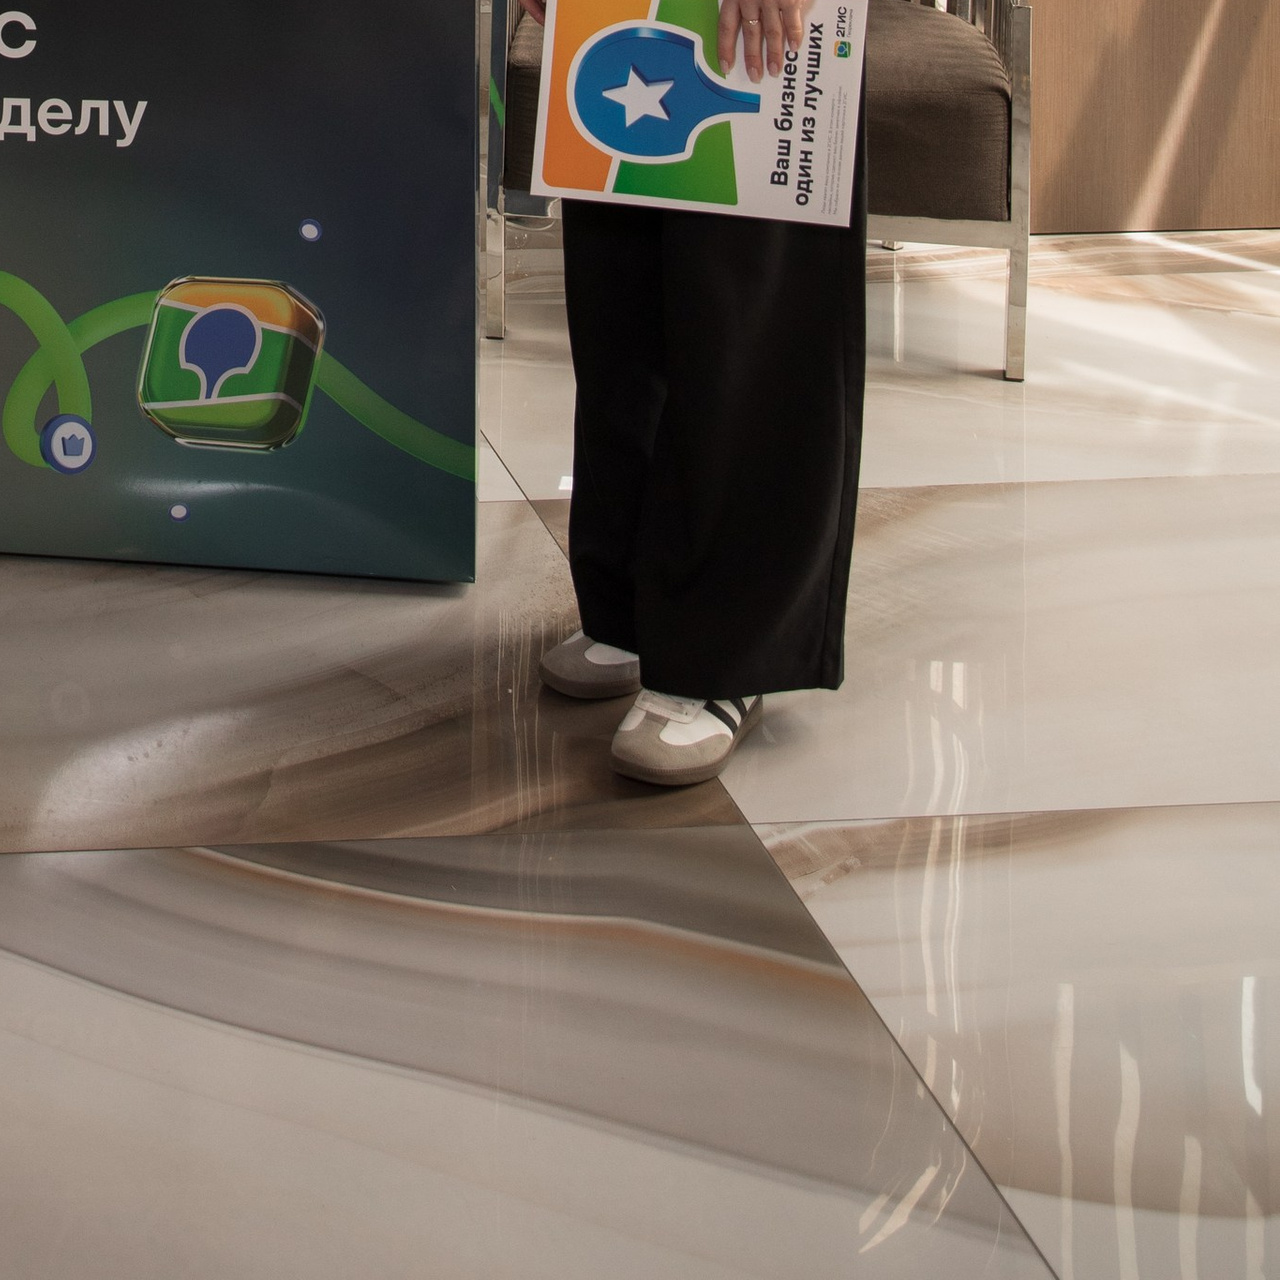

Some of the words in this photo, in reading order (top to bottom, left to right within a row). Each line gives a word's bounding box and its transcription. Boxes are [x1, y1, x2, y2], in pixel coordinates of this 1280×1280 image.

[835, 6, 847, 38] 2ГИС
[774, 49, 799, 132] бизнес
[804, 22, 824, 111] лучших
[801, 116, 816, 144] из
[770, 139, 791, 186] Ваш
[796, 150, 814, 206] один
